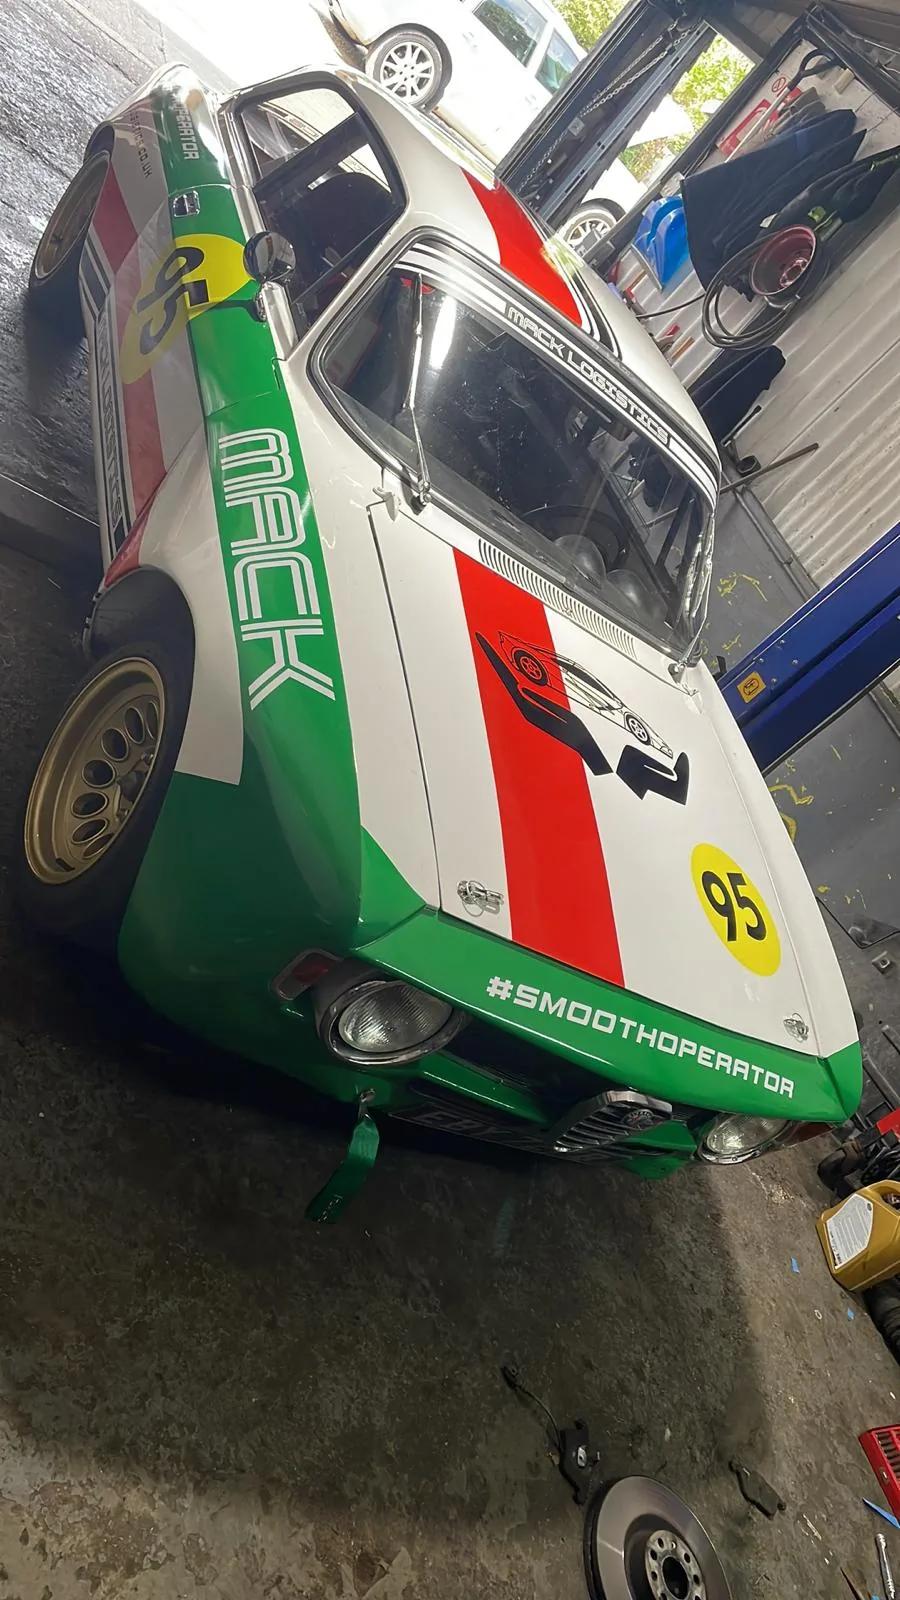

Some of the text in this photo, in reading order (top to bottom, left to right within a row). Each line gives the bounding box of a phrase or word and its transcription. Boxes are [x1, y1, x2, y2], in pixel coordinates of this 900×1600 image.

[136, 246, 210, 356] 95
[507, 306, 670, 446] MACK LOGISTICS
[218, 427, 336, 712] MACK
[701, 870, 767, 942] 95
[486, 975, 795, 1099] #SMOOTHOPERATOR
